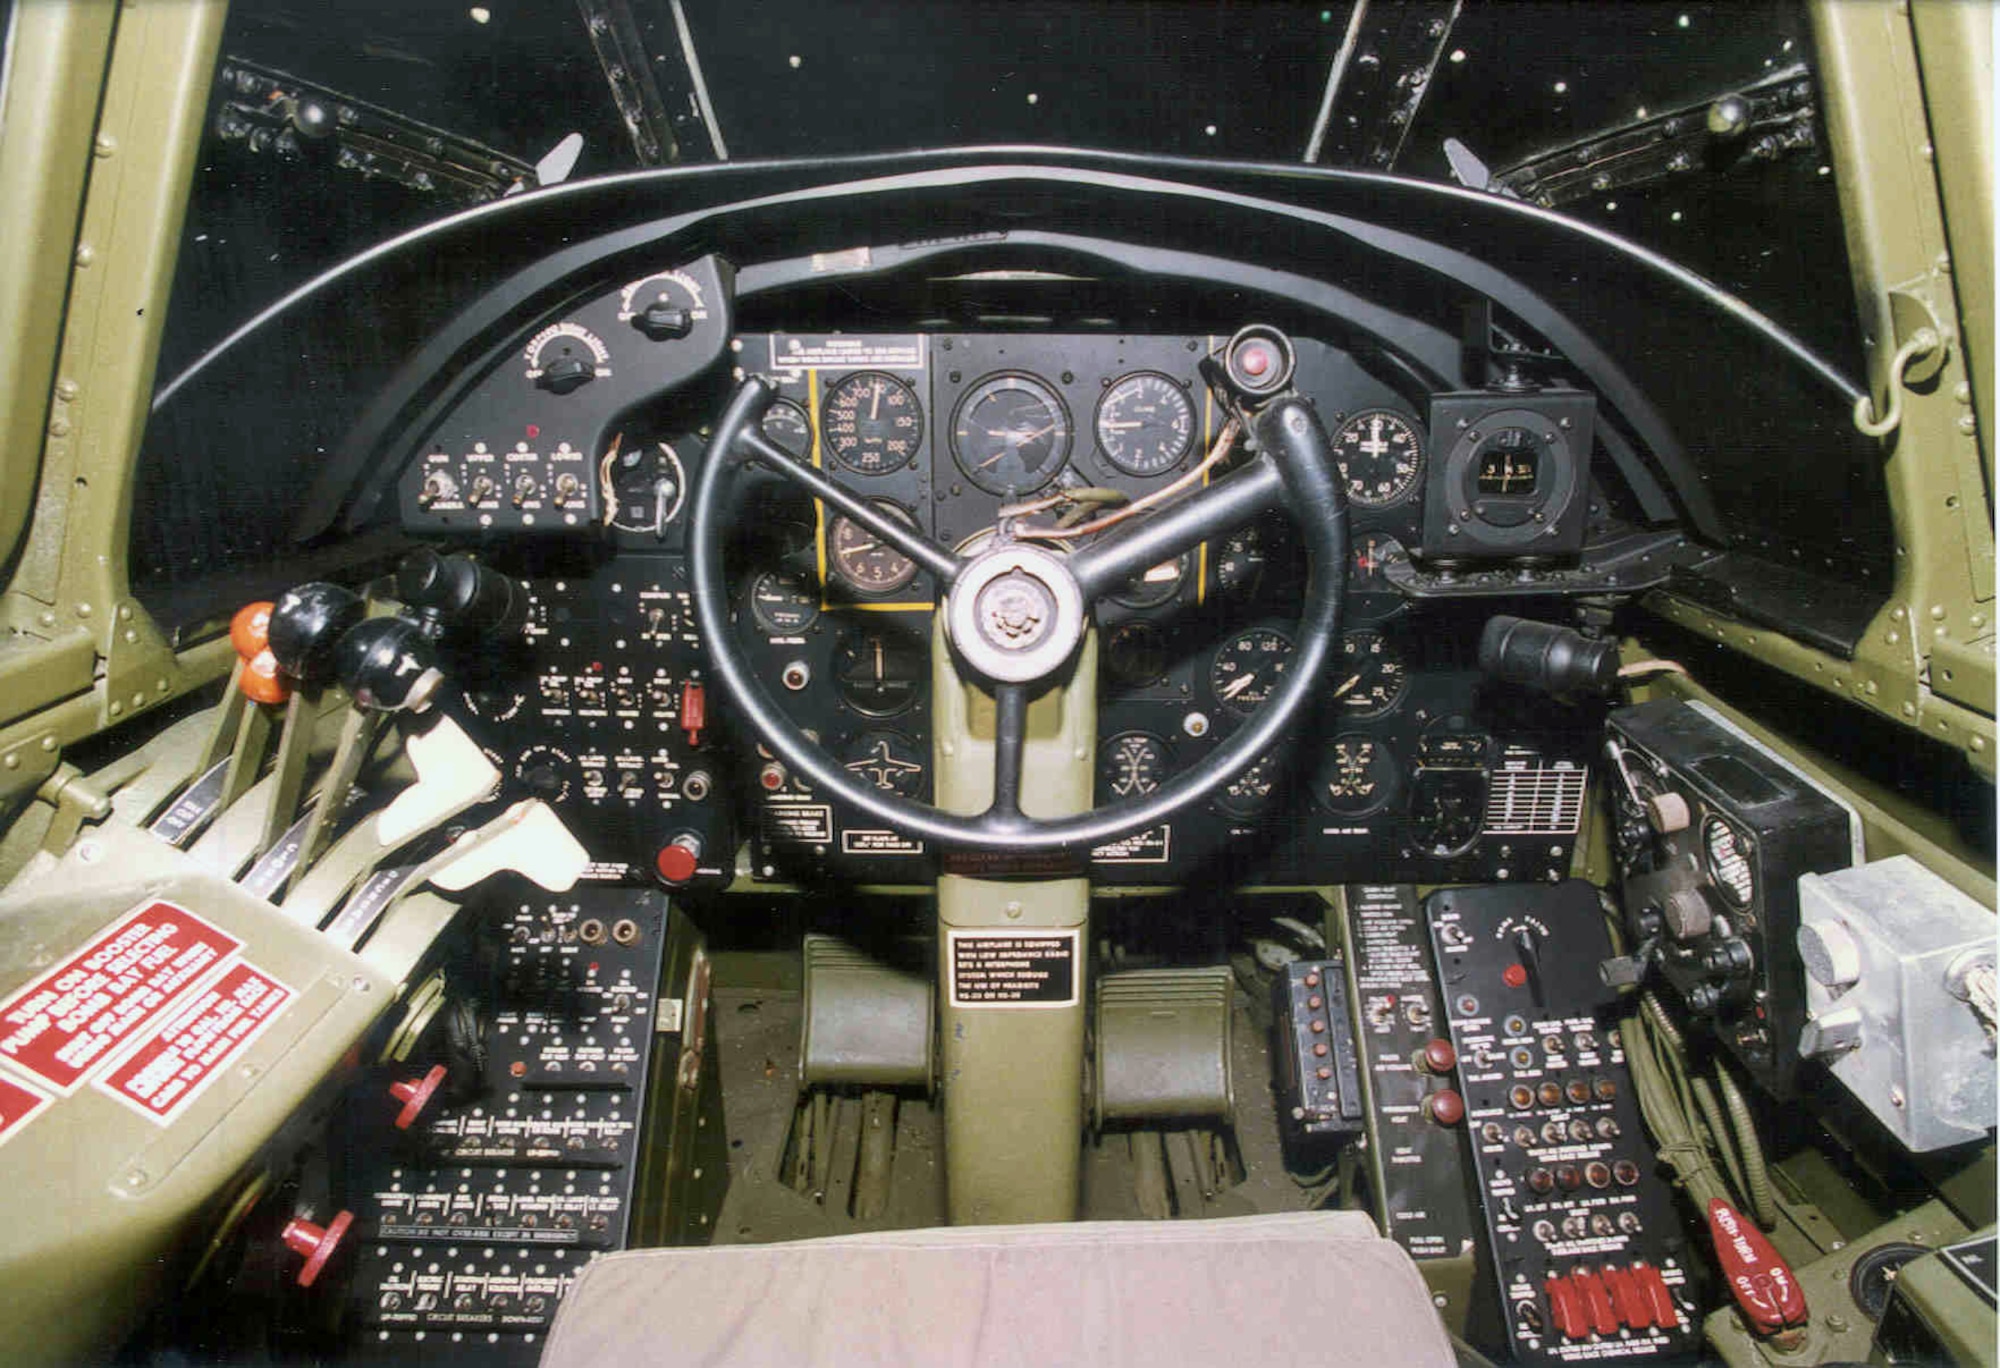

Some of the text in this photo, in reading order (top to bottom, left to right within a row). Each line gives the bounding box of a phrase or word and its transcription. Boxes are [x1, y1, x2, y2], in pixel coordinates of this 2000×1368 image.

[861, 452, 880, 463] 250
[0, 923, 179, 1053] PUMP BEFORE SELECTING
[7, 923, 152, 1024] TURN ON BOOSTER
[57, 945, 179, 1032] BOMB BAY FUEL
[113, 986, 152, 1015] BOMB
[148, 967, 174, 988] BAY
[108, 1006, 147, 1036] MAIN
[143, 990, 164, 1008] OR
[432, 1228, 449, 1238] NOT
[1736, 1276, 1756, 1296] OFF
[1769, 1266, 1788, 1287] ON
[426, 1313, 454, 1321] CIRCUIT
[456, 1313, 492, 1322] BREAKERS
